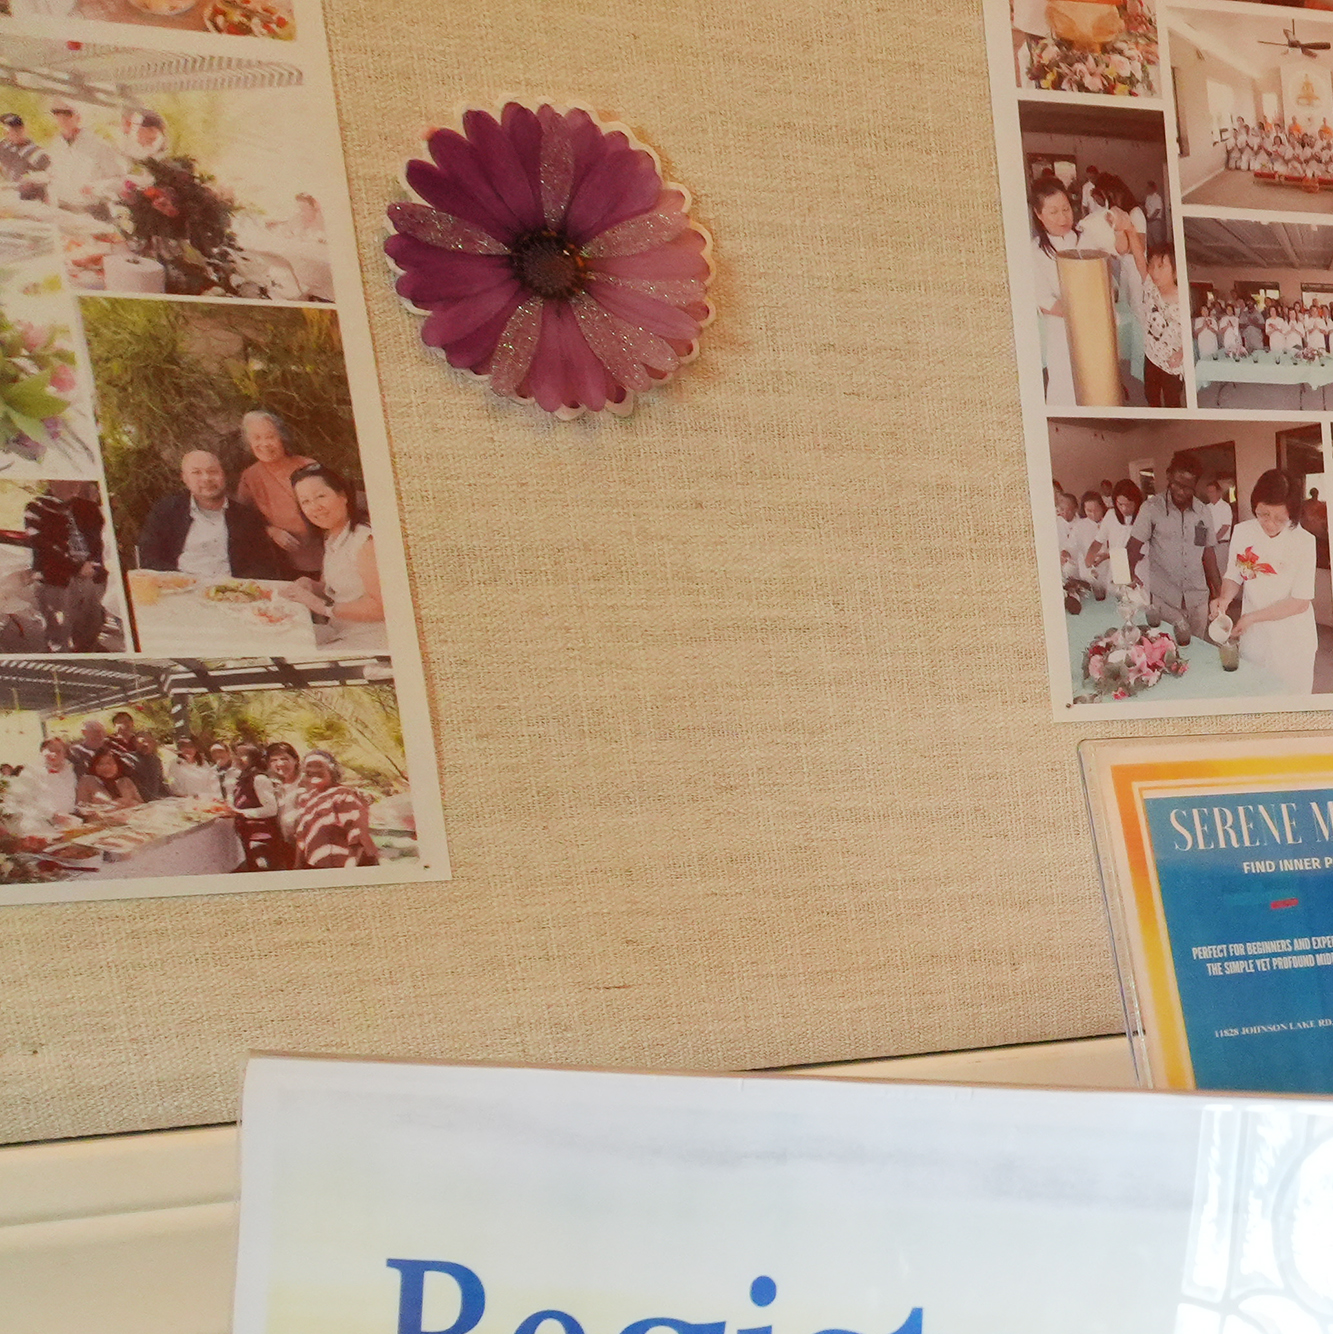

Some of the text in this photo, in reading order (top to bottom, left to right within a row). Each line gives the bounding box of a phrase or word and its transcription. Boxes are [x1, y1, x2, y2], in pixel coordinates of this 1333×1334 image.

[1169, 802, 1302, 851] SERENE
[1242, 860, 1276, 874] FIND
[1279, 857, 1321, 872] INNER
[1191, 944, 1228, 960] PERFECT
[1229, 943, 1246, 957] FOR
[1247, 940, 1292, 955] BEGINNERS
[1293, 938, 1311, 951] AND
[1206, 962, 1224, 976] THE
[1225, 960, 1255, 975] SIMPLE
[1256, 959, 1271, 972] YET
[1273, 955, 1315, 970] PROFOUND
[1214, 1027, 1239, 1038] 11828
[1241, 1022, 1287, 1036] JOHNSON
[1289, 1019, 1316, 1031] LAKE
